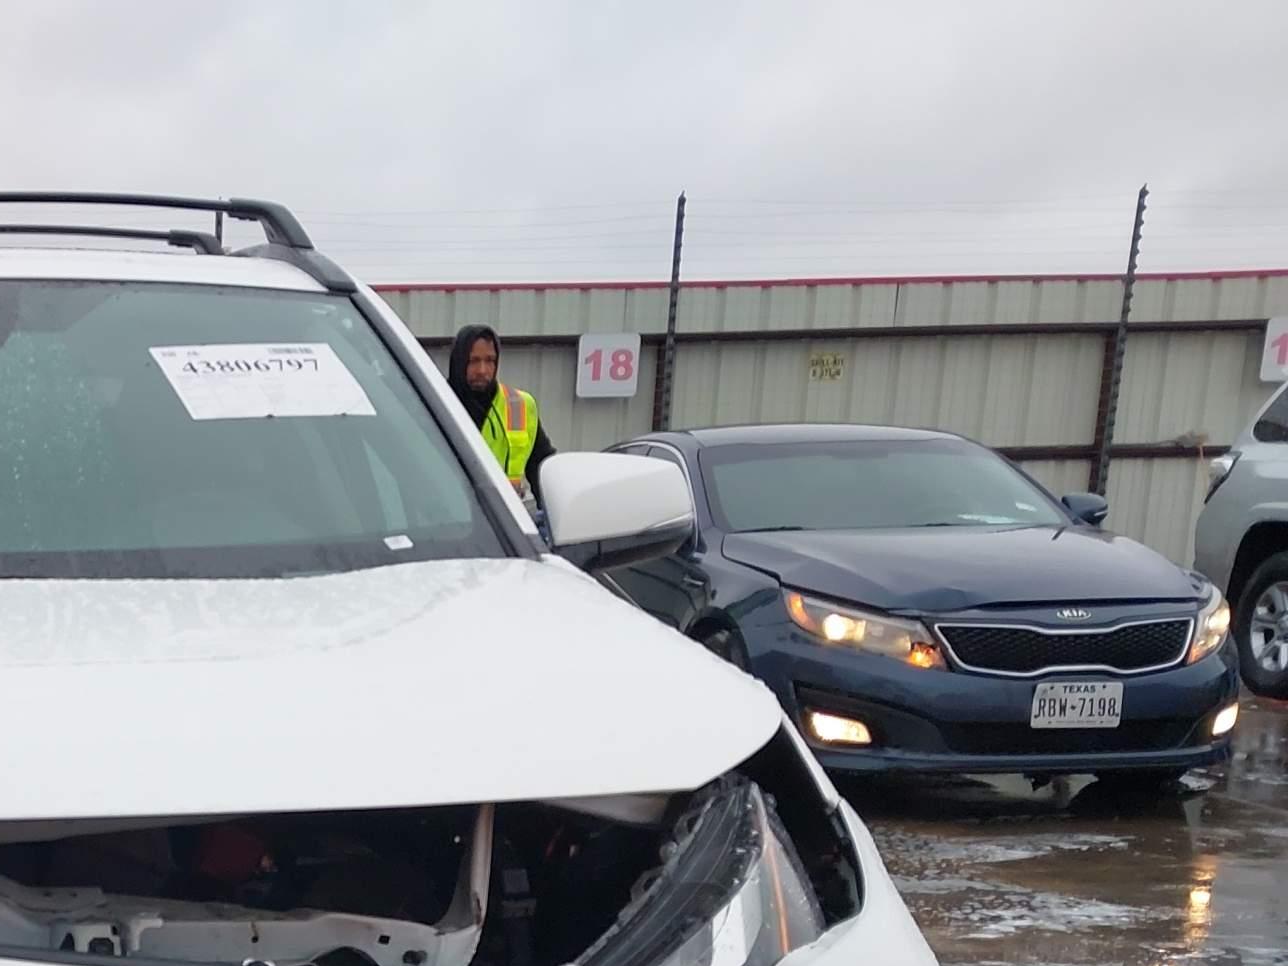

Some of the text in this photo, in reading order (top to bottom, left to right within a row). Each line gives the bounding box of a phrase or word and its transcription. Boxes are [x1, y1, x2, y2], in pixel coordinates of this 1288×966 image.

[181, 358, 319, 374] 43806797
[584, 349, 633, 381] 18
[1060, 608, 1089, 618] KIA
[1062, 685, 1096, 693] TEXAS
